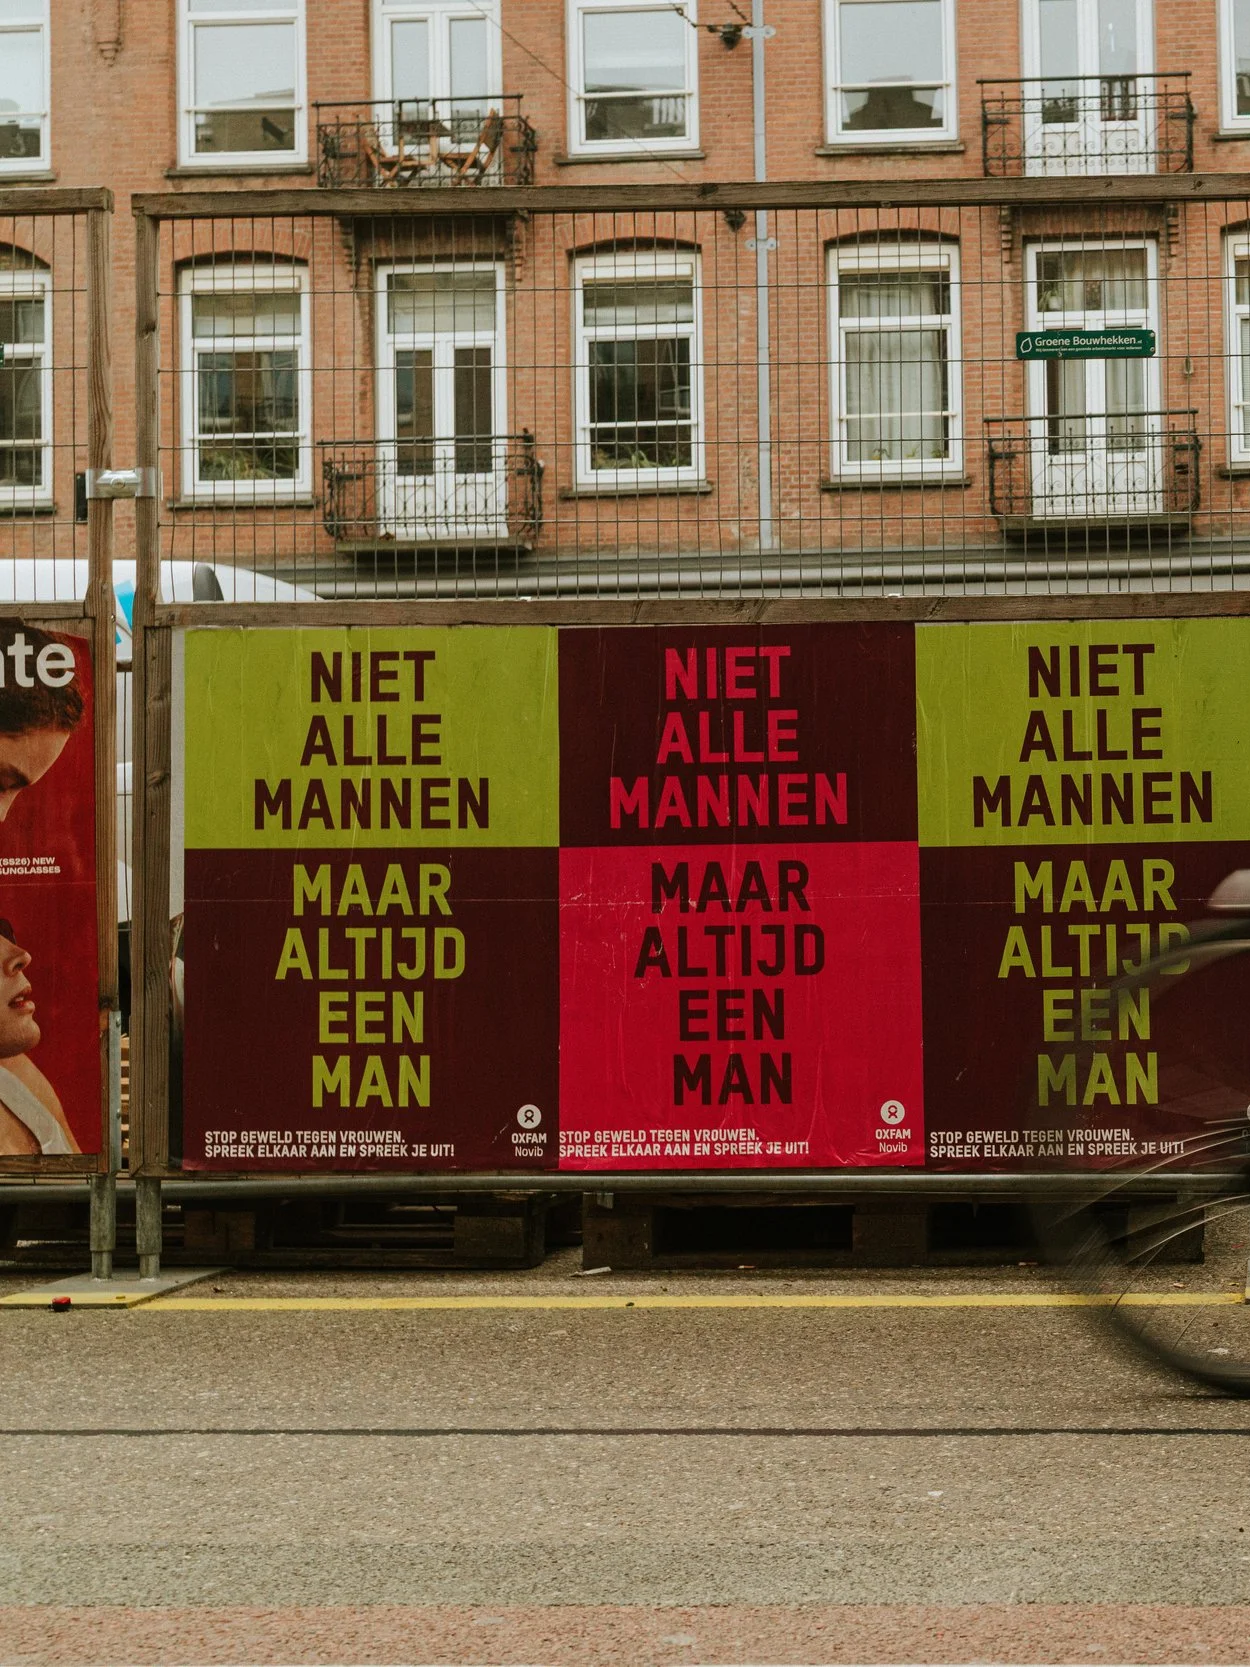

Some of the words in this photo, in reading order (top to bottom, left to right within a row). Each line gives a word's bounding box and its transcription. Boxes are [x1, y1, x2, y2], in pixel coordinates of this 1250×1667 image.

[1034, 337, 1071, 347] Groene
[0, 633, 76, 688] te
[310, 650, 436, 703] NIET
[664, 646, 792, 700] NIET
[1027, 643, 1156, 699] NIET
[299, 714, 442, 767] ALLE
[656, 709, 799, 764] ALLE
[1018, 707, 1164, 763] ALLE
[253, 777, 490, 831] MANNEN
[608, 773, 849, 829] MANNEN
[972, 771, 1214, 828] MANNEN
[0, 857, 30, 867] (SS26)
[32, 857, 56, 865] NEW
[650, 860, 812, 914] MAAR
[1014, 858, 1178, 914] MAAR
[293, 863, 453, 916] MAAR
[274, 927, 466, 981] ALTIJD
[633, 923, 826, 979] ALTIJD
[318, 991, 425, 1044] EEN
[677, 989, 785, 1042] EEN
[1043, 987, 1151, 1042] EEN
[311, 1054, 431, 1109] MAN
[672, 1052, 794, 1107] MAN
[1037, 1051, 1159, 1106] MAN
[205, 1131, 237, 1144] STOP
[241, 1131, 292, 1143] GEWELD
[296, 1131, 336, 1143] TEGEN
[340, 1130, 405, 1143] VROUWEN.
[205, 1145, 254, 1158] SPREEK
[257, 1145, 307, 1157] ELKAAR
[310, 1145, 336, 1157] AAN
[339, 1144, 356, 1157] EN
[359, 1144, 408, 1157] SPREEK
[411, 1144, 427, 1157] JE
[430, 1144, 454, 1156] UIT!
[511, 1133, 547, 1144] OXFAM
[515, 1146, 543, 1157] Novib
[559, 1131, 591, 1144] STOP
[594, 1130, 647, 1143] GEWELD
[650, 1129, 690, 1142] TEGEN
[694, 1129, 759, 1141] VROUWEN.
[559, 1144, 608, 1157] SPREEK
[611, 1144, 661, 1156] ELKAAR
[664, 1143, 690, 1156] AAN
[694, 1143, 710, 1155] EN
[714, 1142, 763, 1155] SPREEK
[766, 1142, 782, 1154] JE
[785, 1141, 809, 1154] UIT!
[875, 1128, 911, 1140] OXFAM
[879, 1141, 908, 1153] Novib
[930, 1131, 962, 1144] STOP
[966, 1130, 1019, 1143] GEWELD
[1022, 1130, 1063, 1142] TEGEN
[1067, 1129, 1134, 1142] VROUWEN.
[930, 1145, 980, 1158] SPREEK
[984, 1144, 1034, 1157] ELKAAR
[1038, 1144, 1064, 1156] AAN
[1067, 1143, 1084, 1156] EN
[1088, 1143, 1138, 1156] SPREEK
[1141, 1142, 1156, 1155] JE
[1160, 1142, 1184, 1154] UIT!
